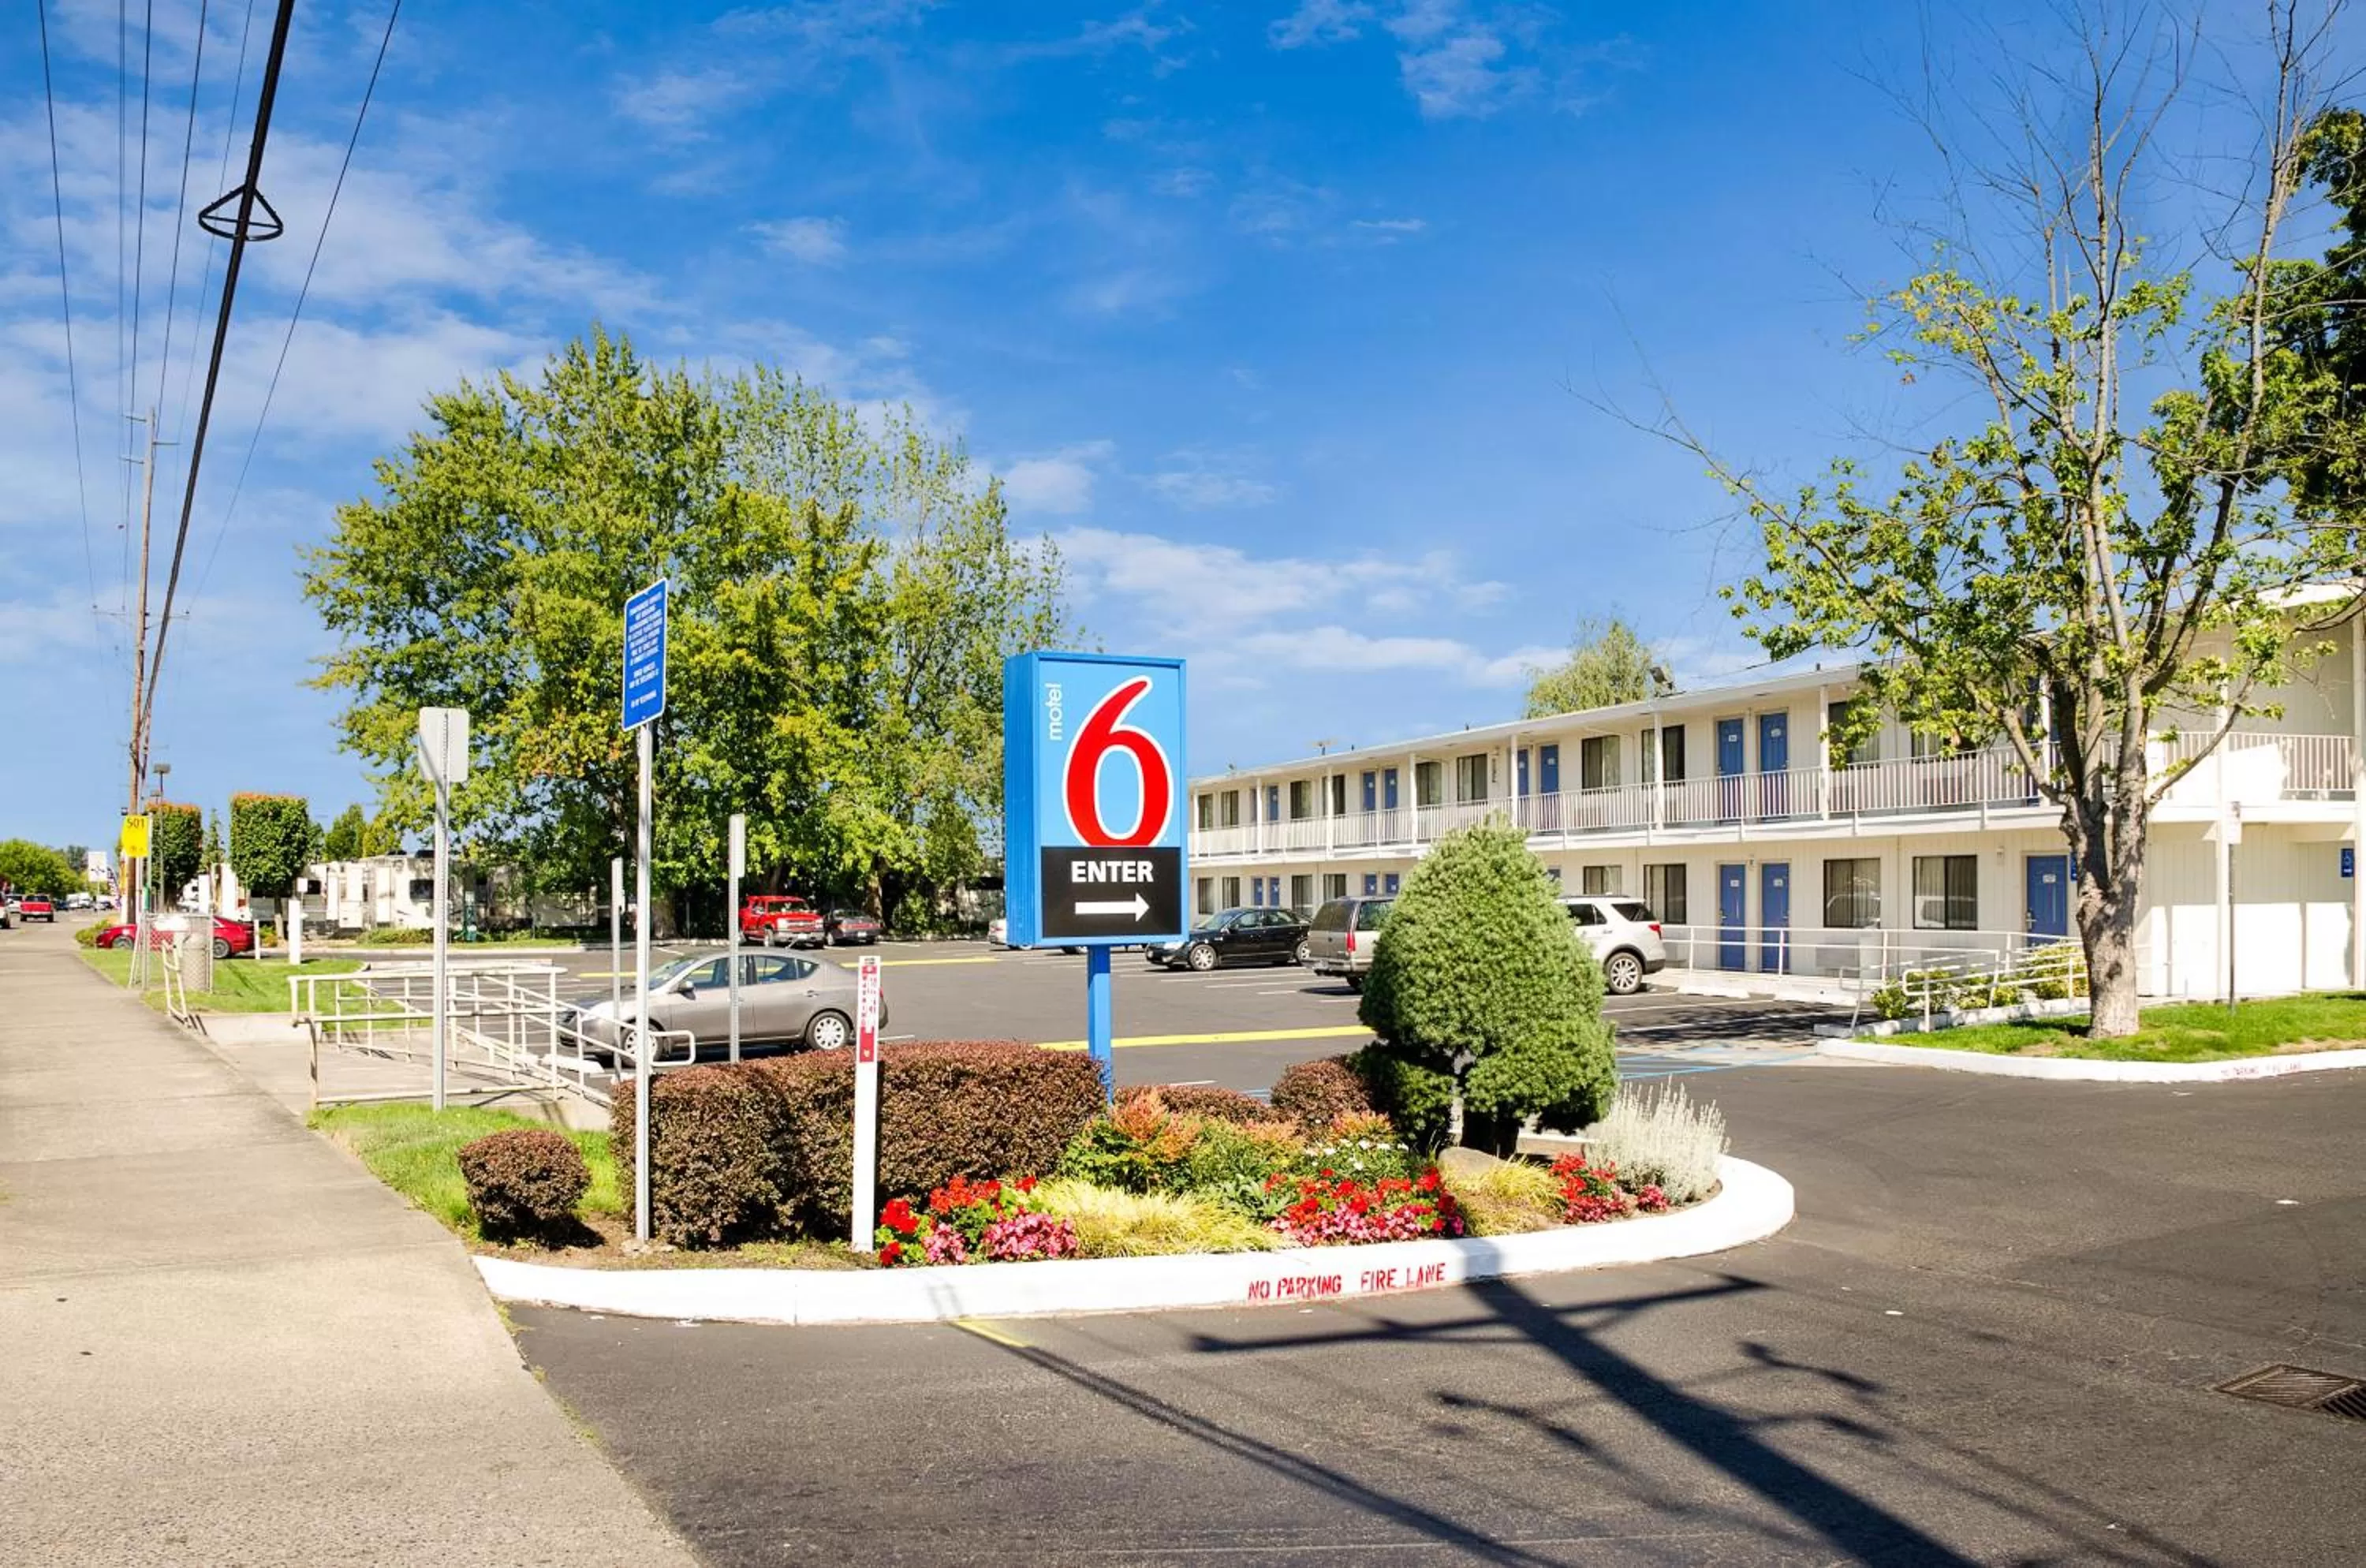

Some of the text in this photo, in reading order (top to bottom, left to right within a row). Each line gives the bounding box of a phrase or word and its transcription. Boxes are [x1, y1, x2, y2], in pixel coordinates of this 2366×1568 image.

[1045, 683, 1062, 741] motel
[1062, 675, 1174, 847] 6
[1071, 861, 1154, 883] ENTER
[1248, 1263, 1446, 1300] NO PARKING FIRE LANE
